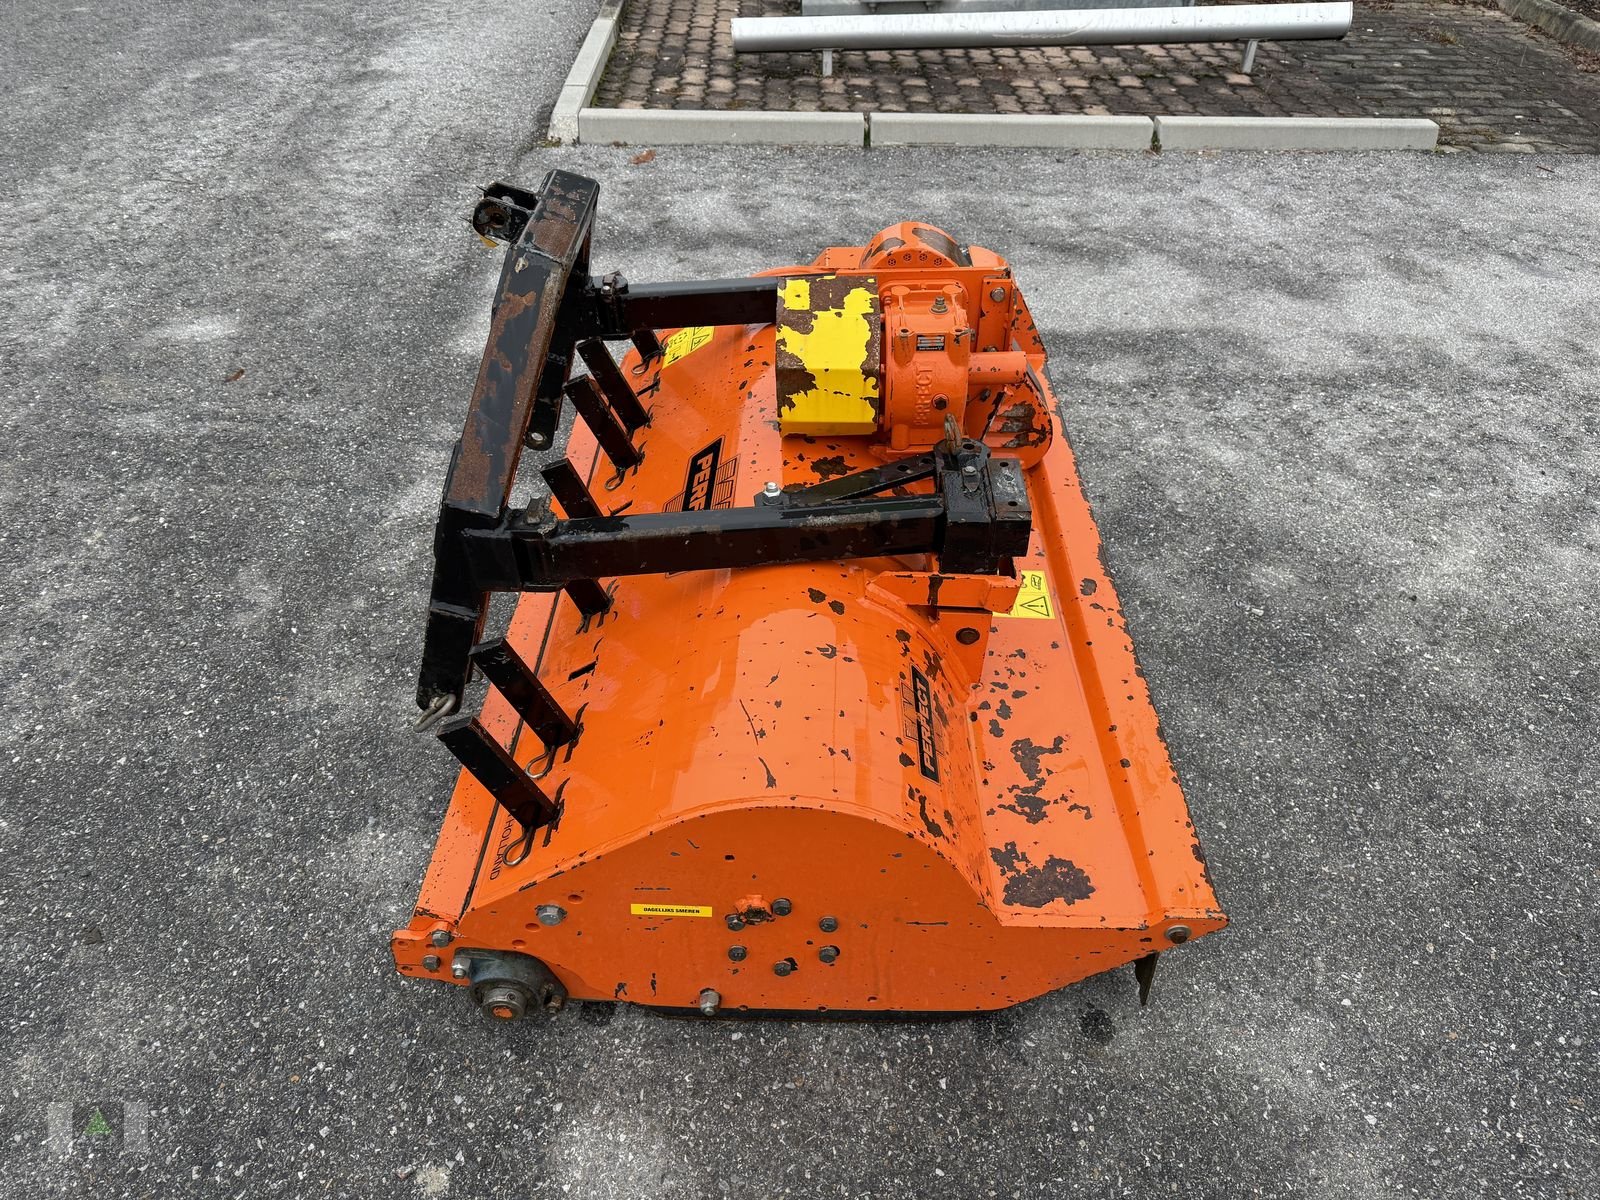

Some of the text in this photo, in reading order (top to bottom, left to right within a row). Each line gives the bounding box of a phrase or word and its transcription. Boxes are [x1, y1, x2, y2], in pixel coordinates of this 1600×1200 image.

[914, 366, 933, 425] PERFECT
[688, 452, 714, 510] PERF
[916, 678, 935, 773] PERFECT
